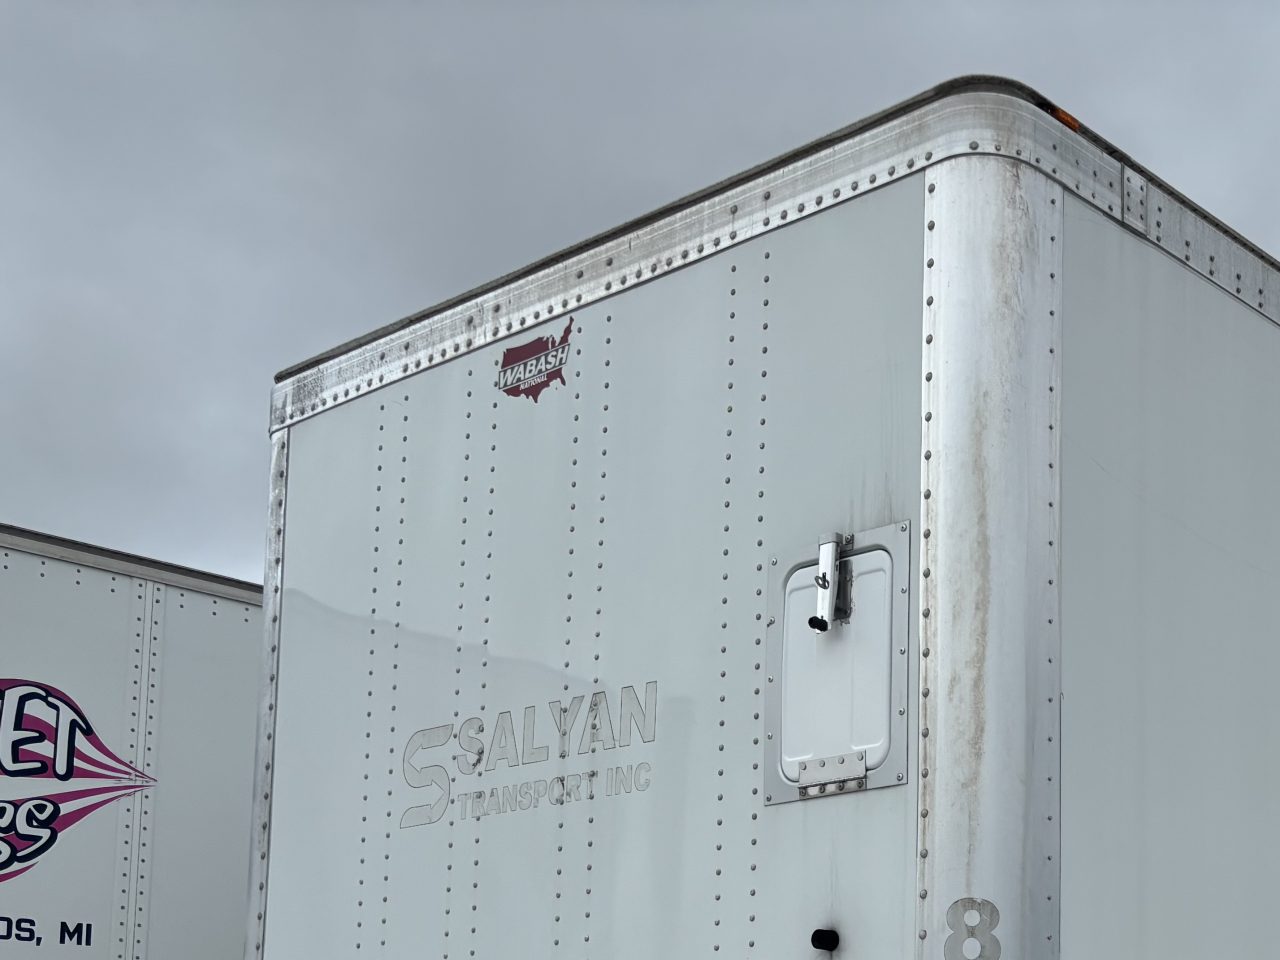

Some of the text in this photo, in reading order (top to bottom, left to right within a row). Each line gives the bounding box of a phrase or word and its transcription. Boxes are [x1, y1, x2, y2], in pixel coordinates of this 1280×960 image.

[499, 344, 570, 389] WABASH
[0, 684, 93, 781] ET
[457, 681, 658, 776] SALYAN
[458, 762, 652, 820] TRANSPORT INC
[60, 921, 92, 946] MI
